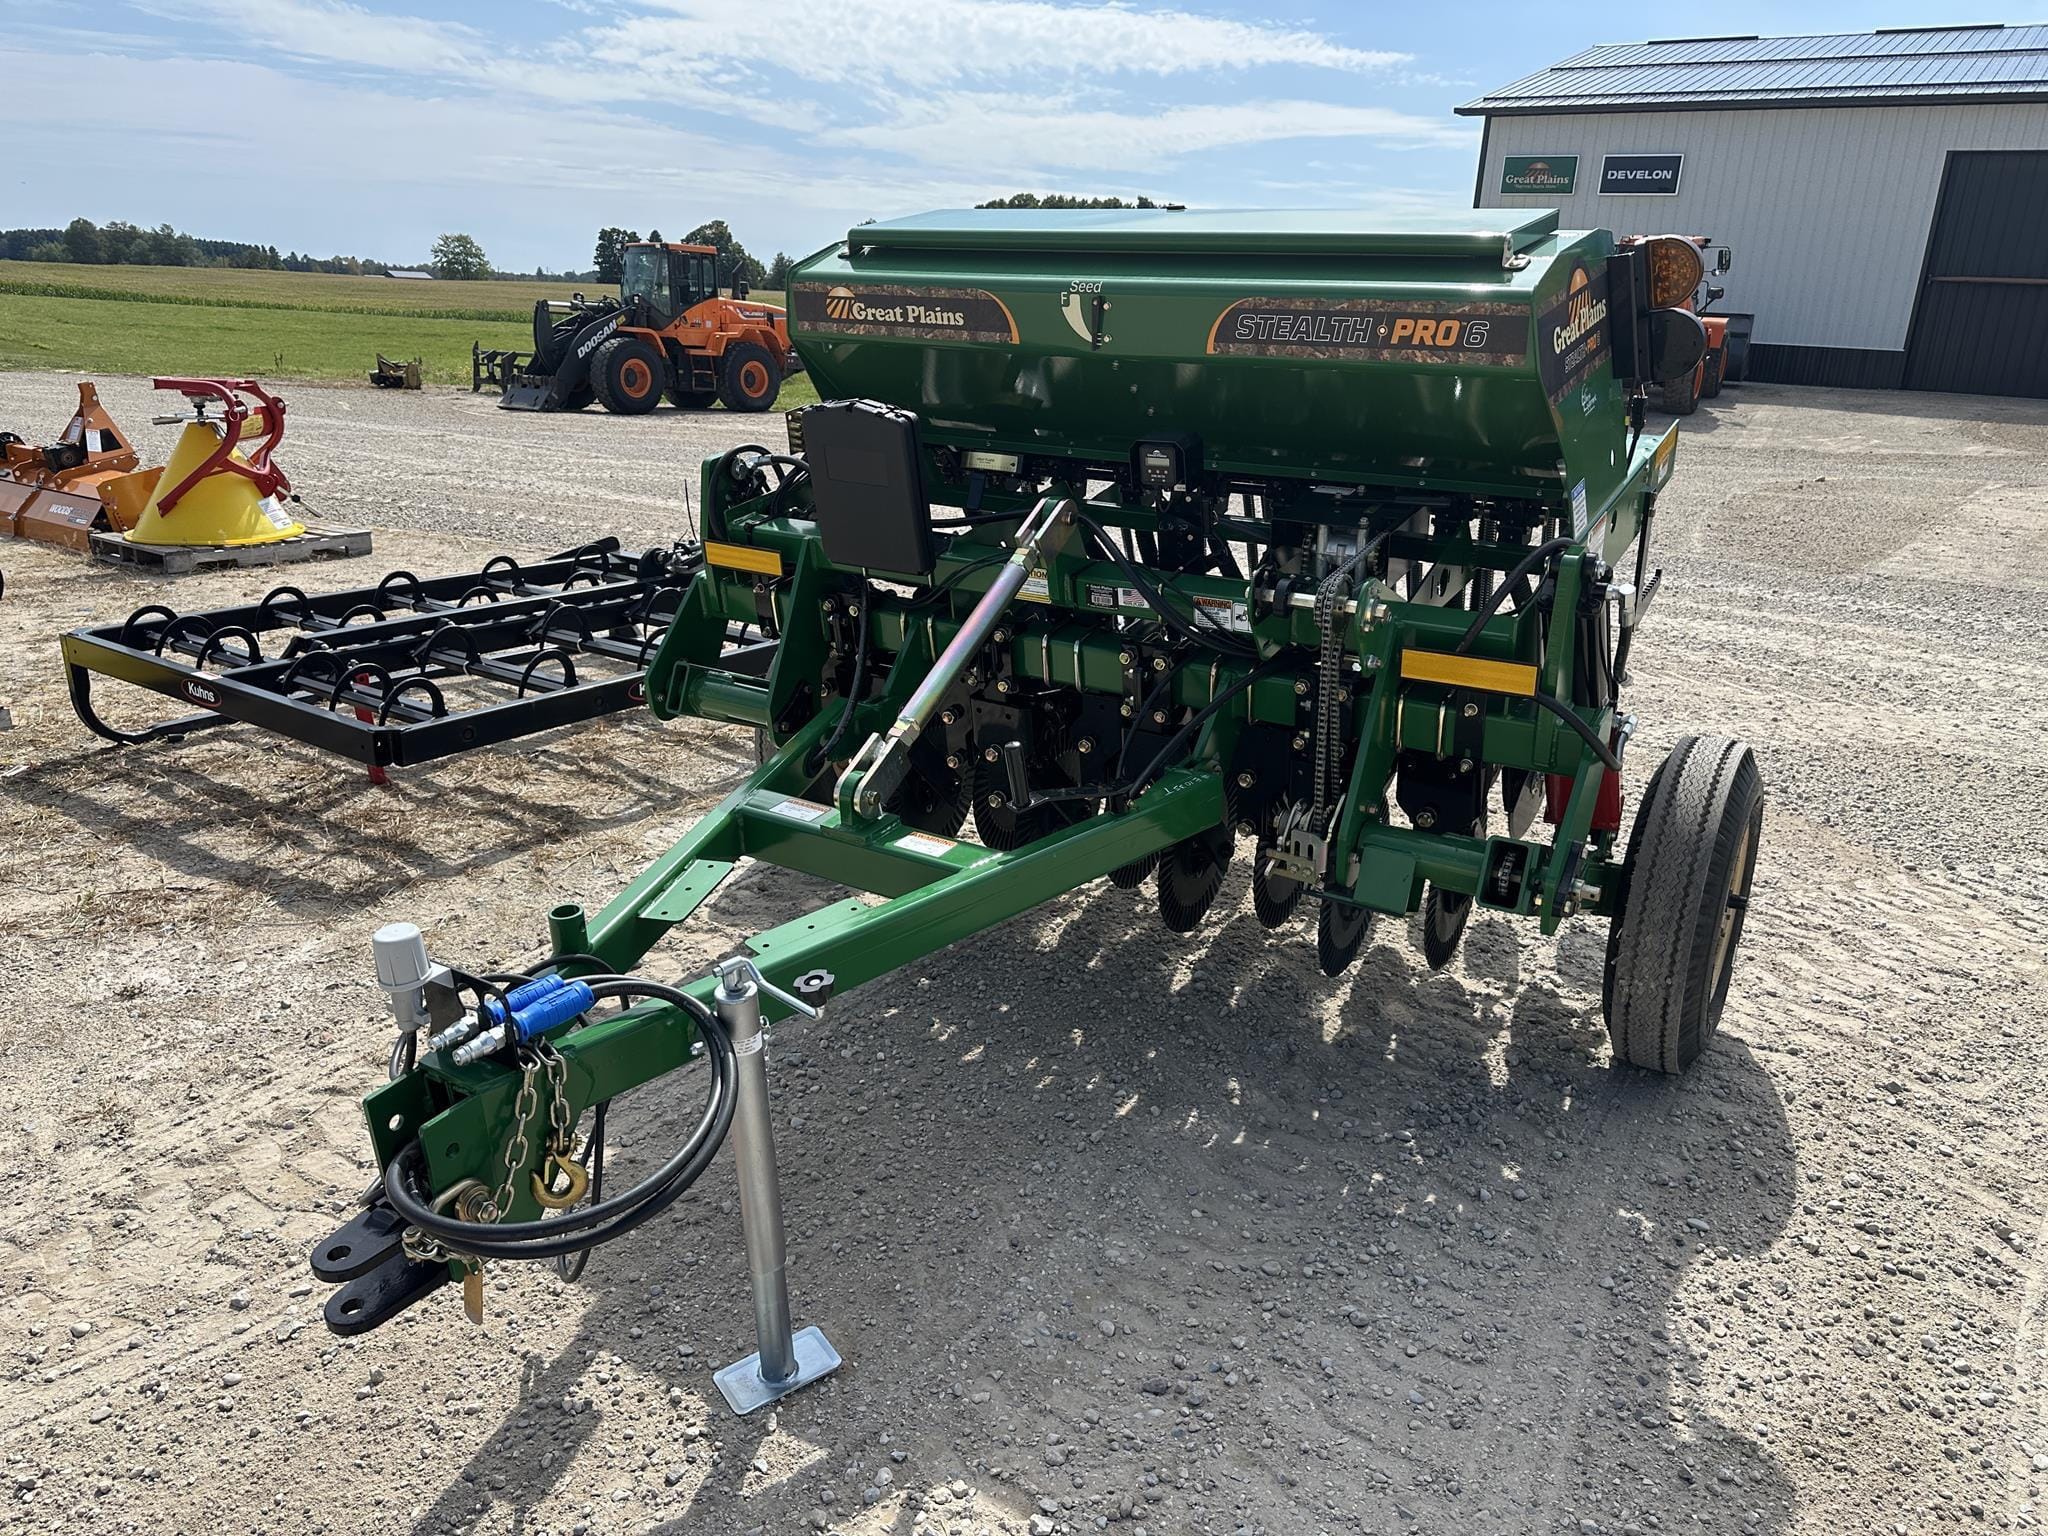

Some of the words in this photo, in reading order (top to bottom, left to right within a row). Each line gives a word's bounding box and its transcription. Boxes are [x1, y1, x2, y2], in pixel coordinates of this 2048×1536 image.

[1505, 174, 1535, 184] Great
[1536, 174, 1570, 184] Plains
[1607, 169, 1673, 180] DEVELON
[1069, 279, 1104, 293] Seed
[1060, 291, 1068, 305] F
[851, 302, 904, 323] Great
[905, 304, 965, 327] Plains
[1234, 313, 1374, 343] STEALTH
[1390, 317, 1461, 347] PRO
[1463, 319, 1490, 348] 6
[1553, 316, 1581, 355] Great
[1579, 298, 1607, 334] Plains
[576, 318, 618, 360] DOOSAN
[49, 503, 71, 516] WOODS
[187, 681, 215, 702] Kuhns
